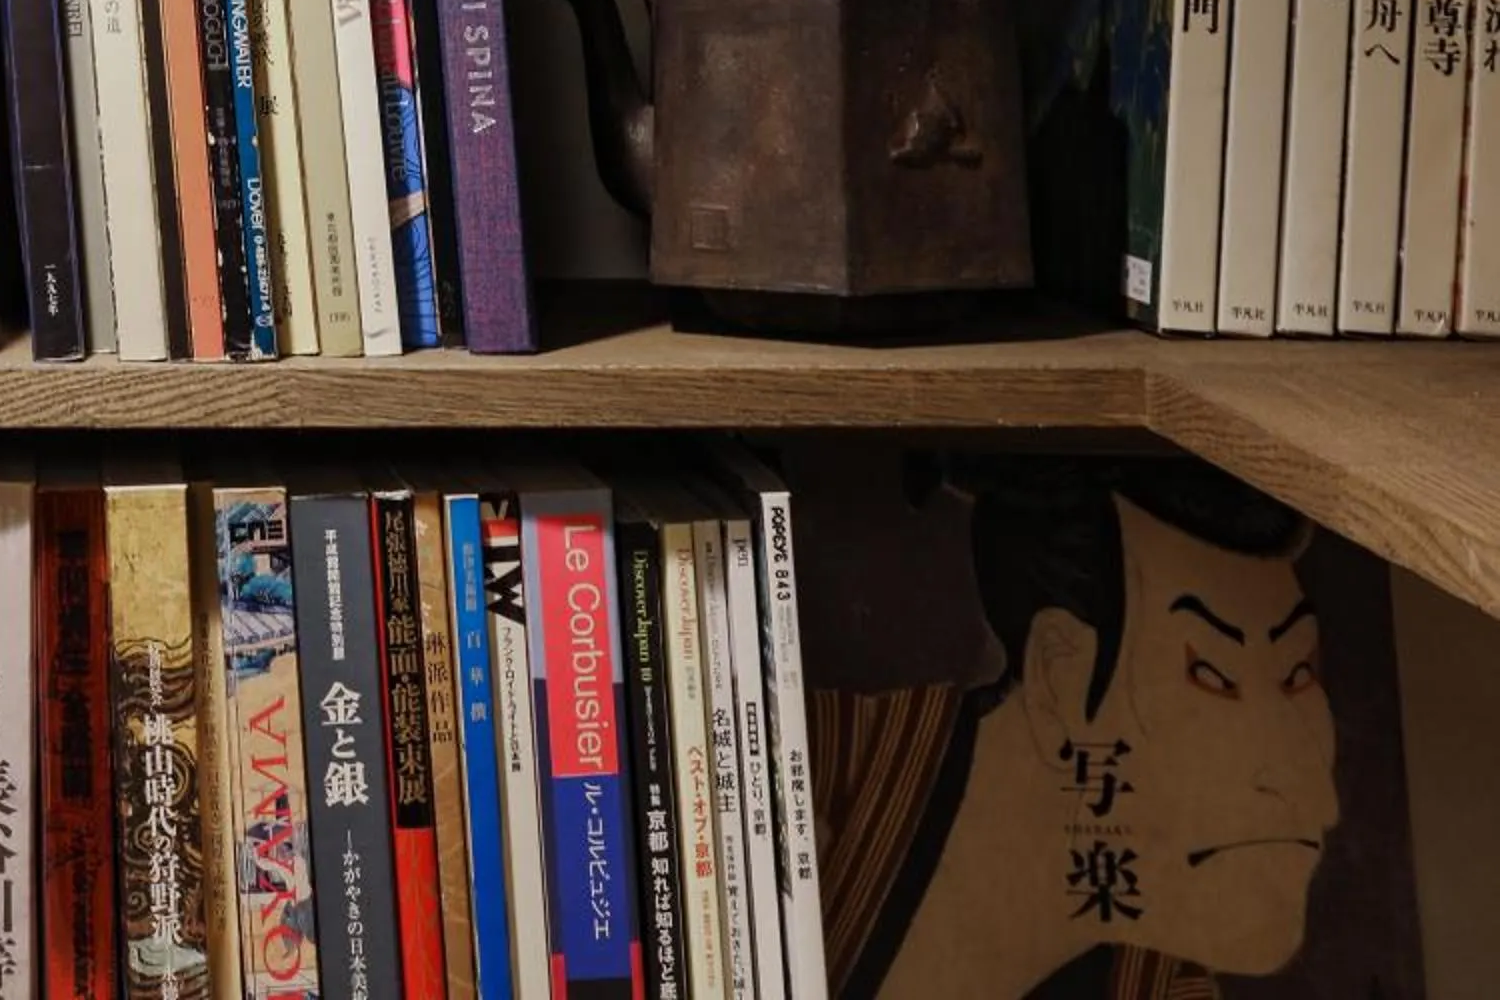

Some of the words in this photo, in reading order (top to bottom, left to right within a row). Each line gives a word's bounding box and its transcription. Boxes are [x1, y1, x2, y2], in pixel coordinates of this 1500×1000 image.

[462, 23, 497, 135] SPINA
[246, 178, 264, 230] Dover
[563, 523, 597, 573] Le
[731, 536, 749, 568] pen
[771, 505, 789, 563] POPEYE
[775, 568, 792, 602] 843
[567, 582, 610, 772] Corbusier
[320, 680, 370, 807] 金と銀
[143, 713, 184, 945] 桃山時代の狩野派
[249, 695, 303, 1000] OYAMA
[581, 781, 611, 942] ル・コルビュジエ
[646, 810, 669, 853] 京都
[1058, 737, 1144, 923] 写楽
